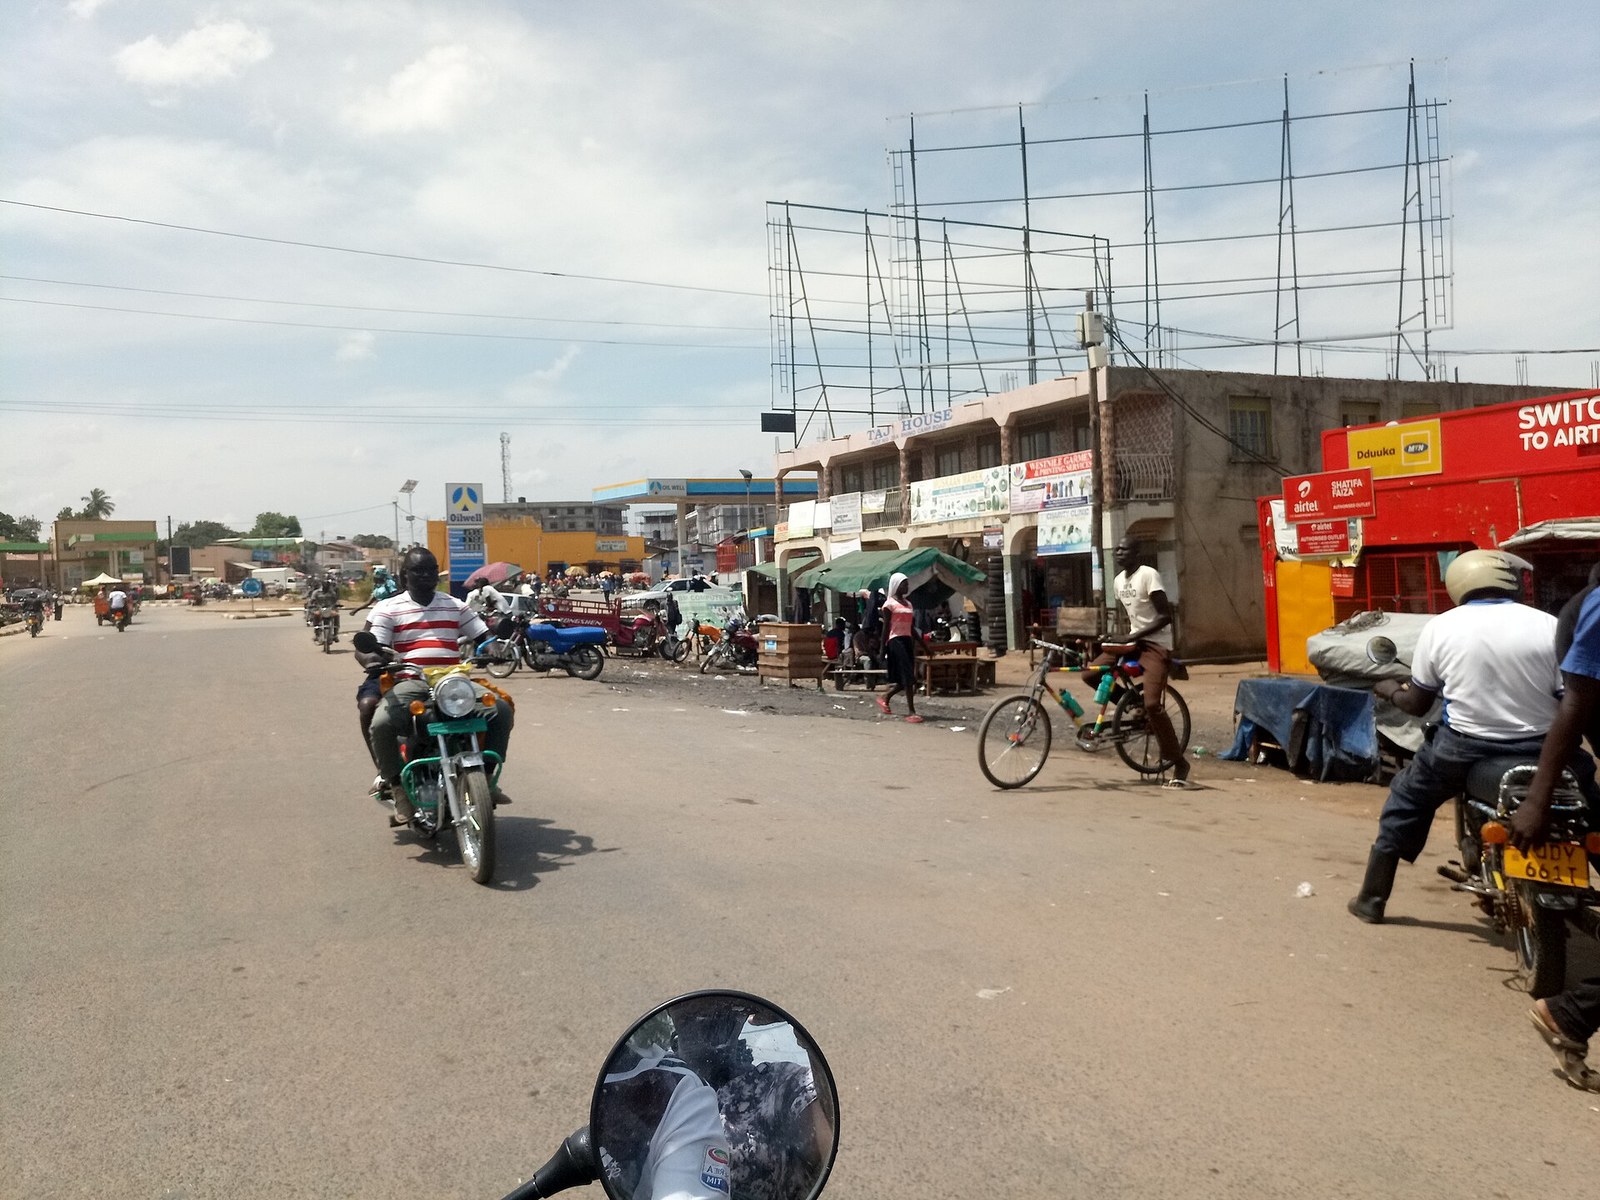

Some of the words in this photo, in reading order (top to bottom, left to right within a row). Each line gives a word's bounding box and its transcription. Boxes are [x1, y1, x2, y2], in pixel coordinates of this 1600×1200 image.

[866, 426, 891, 440] TAJ
[901, 408, 953, 431] HOUSE
[1519, 431, 1548, 451] TO
[1553, 424, 1600, 447] AIRT
[1357, 447, 1396, 460] Dduuka
[1408, 444, 1424, 453] MTN
[1029, 457, 1063, 470] WESTNILE
[1331, 478, 1363, 490] SHATIFA
[1332, 489, 1354, 498] FAIZA
[1293, 500, 1319, 513] airtel
[450, 513, 482, 522] Oilwell
[1317, 522, 1332, 531] airtel
